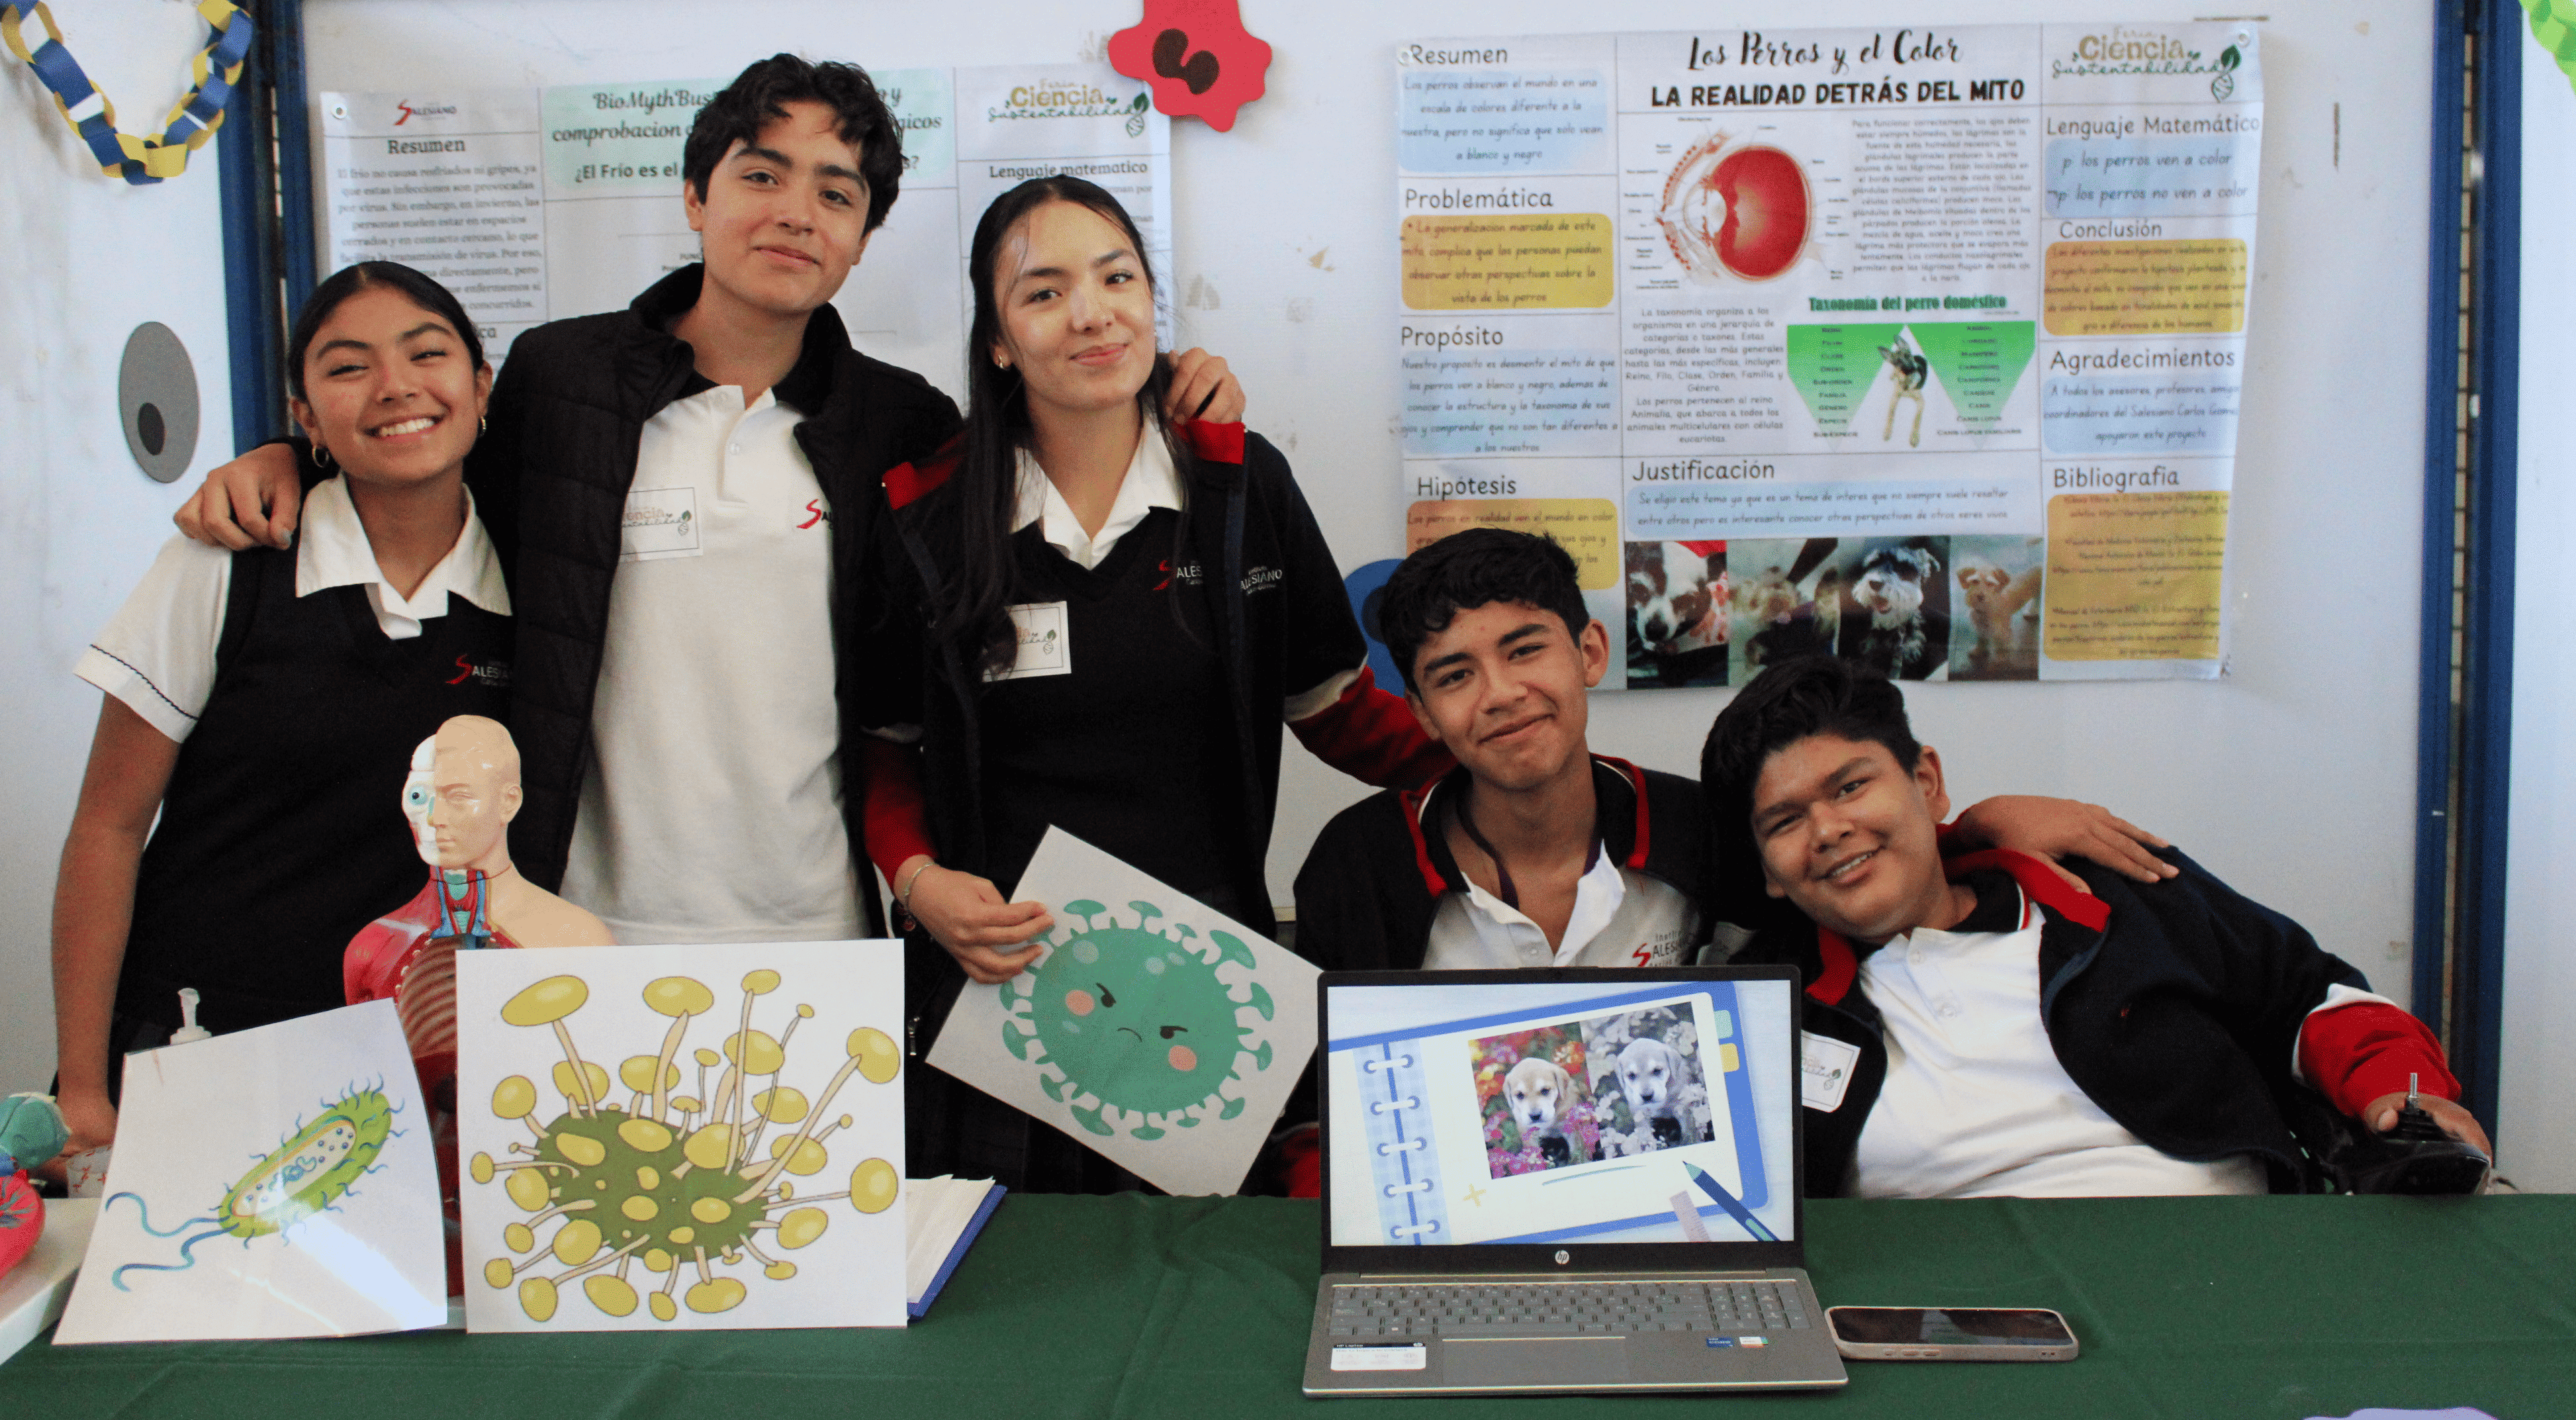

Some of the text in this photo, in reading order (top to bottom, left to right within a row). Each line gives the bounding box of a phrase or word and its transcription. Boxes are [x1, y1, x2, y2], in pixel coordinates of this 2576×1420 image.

[1410, 44, 1508, 65] Resumen
[1688, 28, 1963, 74] Los Perros y el Color
[2079, 35, 2184, 61] Ciencia
[592, 88, 713, 115] BioMythBus
[1010, 85, 1105, 108] Ciencia
[1652, 75, 2025, 107] LA REALIDAD DETRÁS DEL MITO
[553, 119, 681, 147] comprobacion
[2047, 113, 2260, 140] Lenguaje Matemático
[387, 139, 466, 154] Resumen
[575, 164, 596, 183] ¿El
[639, 166, 658, 177] es
[663, 162, 678, 177] el
[989, 161, 1148, 180] Lenguaje matematico
[2062, 149, 2233, 175] p los perros ven a color
[1406, 185, 1554, 209] Problemática
[2060, 218, 2162, 238] Conclusión
[1882, 296, 1901, 310] del
[1906, 297, 1940, 312] perro
[1401, 325, 1504, 353] Propósito
[2050, 348, 2235, 375] Agradecimientos
[1632, 459, 1775, 481] Justificación
[1418, 475, 1517, 501] Hipótesis
[1240, 569, 1283, 591] ALESIANO
